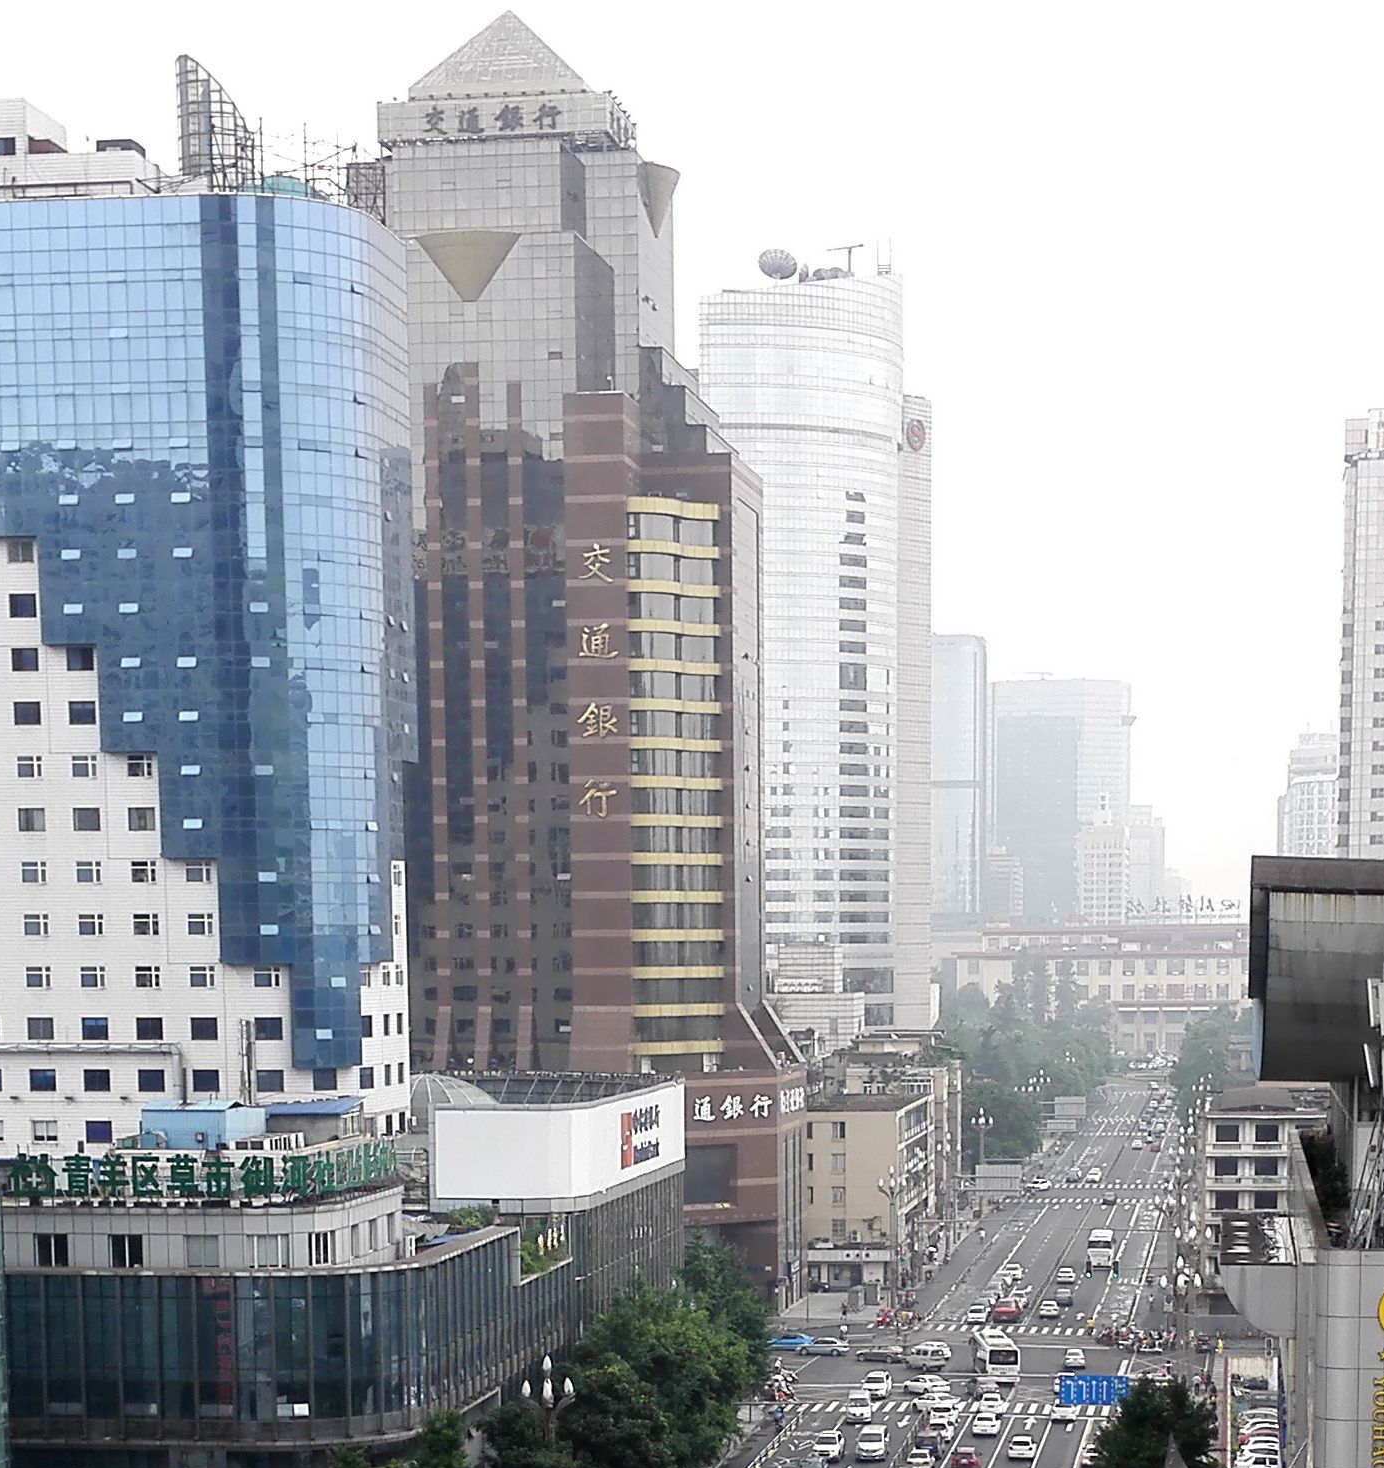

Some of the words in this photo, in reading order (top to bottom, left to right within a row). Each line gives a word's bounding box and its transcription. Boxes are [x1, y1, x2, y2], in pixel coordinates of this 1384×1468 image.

[423, 104, 562, 135] 交通銀行
[578, 543, 619, 818] 交通銀行
